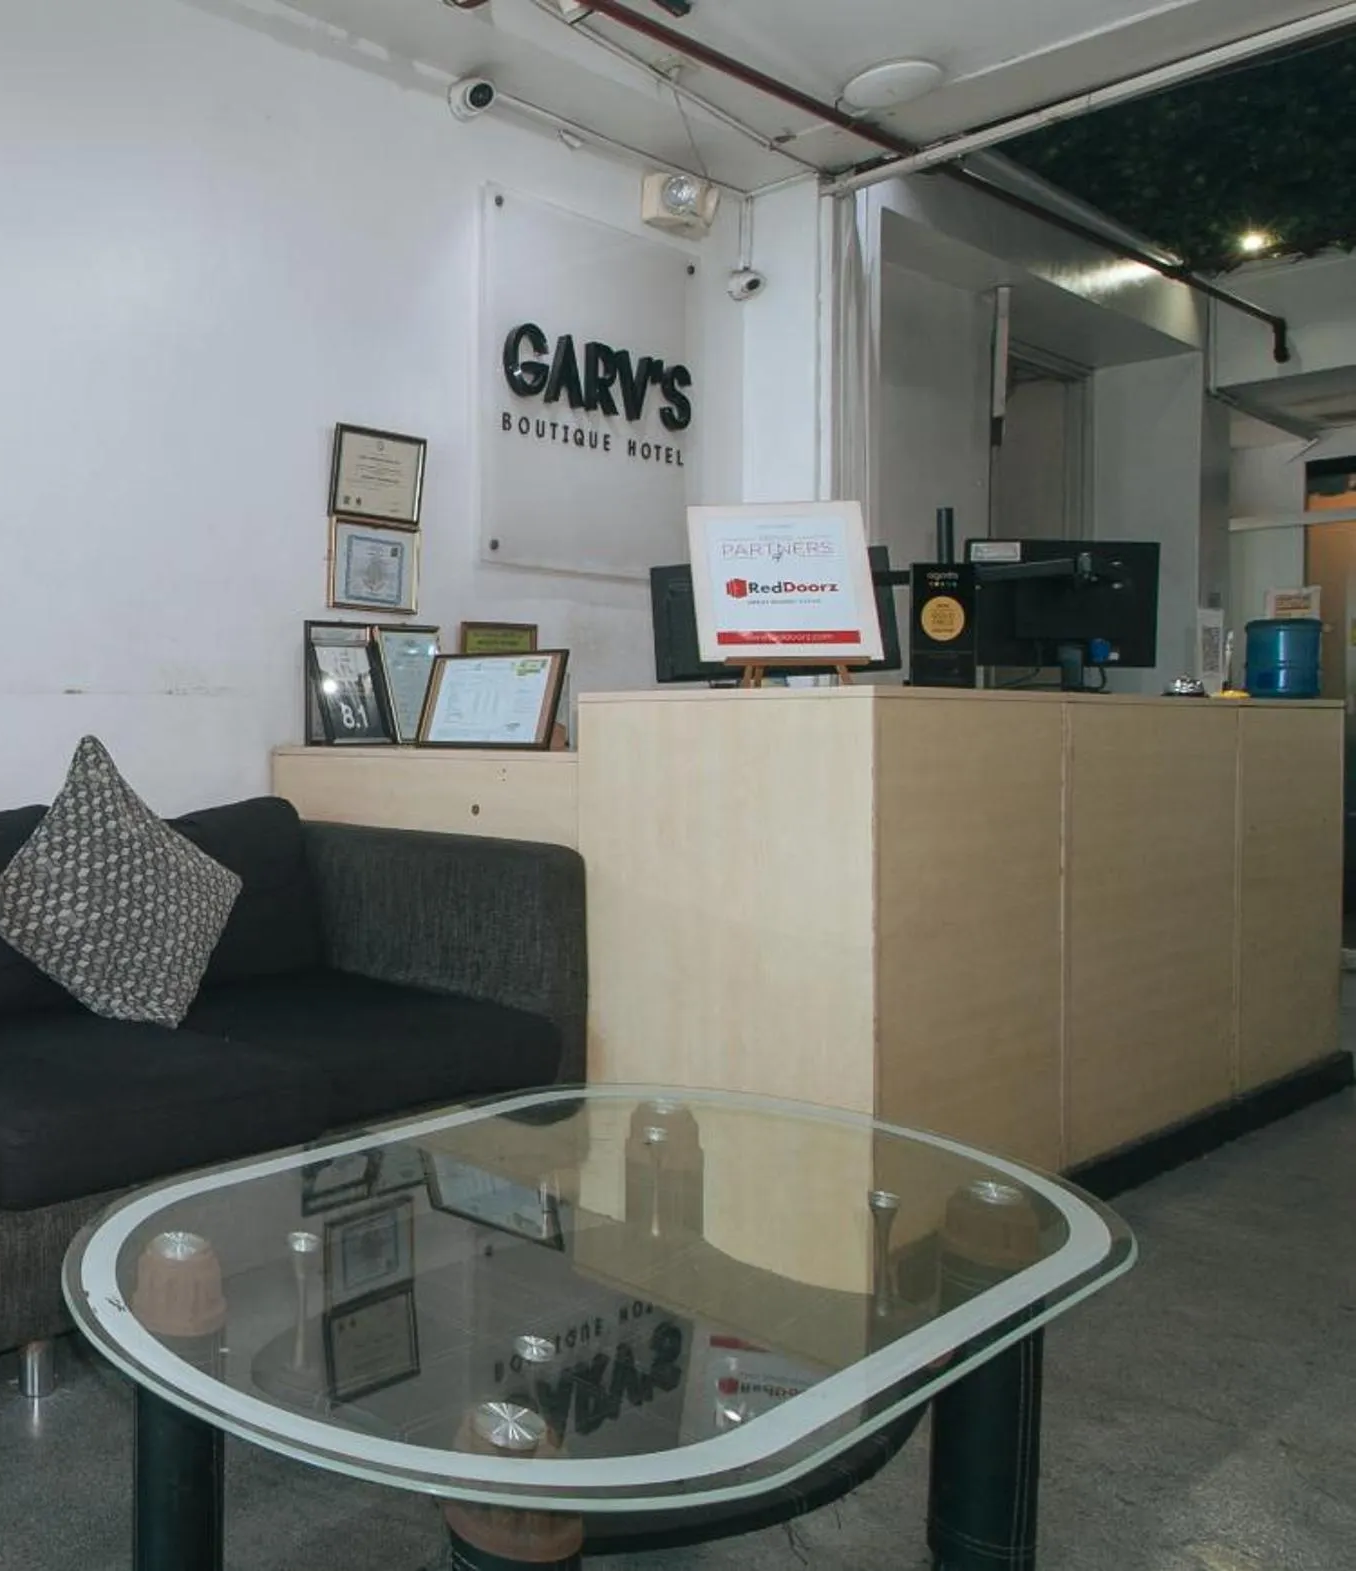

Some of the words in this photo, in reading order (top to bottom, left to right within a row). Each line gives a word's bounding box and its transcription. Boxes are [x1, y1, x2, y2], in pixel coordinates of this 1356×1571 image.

[503, 322, 692, 432] GARV'S
[501, 411, 612, 452] BOUTIQUE
[627, 438, 685, 467] HOTEL
[722, 541, 835, 556] PARTNERS
[748, 581, 840, 594] RedDoorz
[340, 701, 369, 729] 8.1
